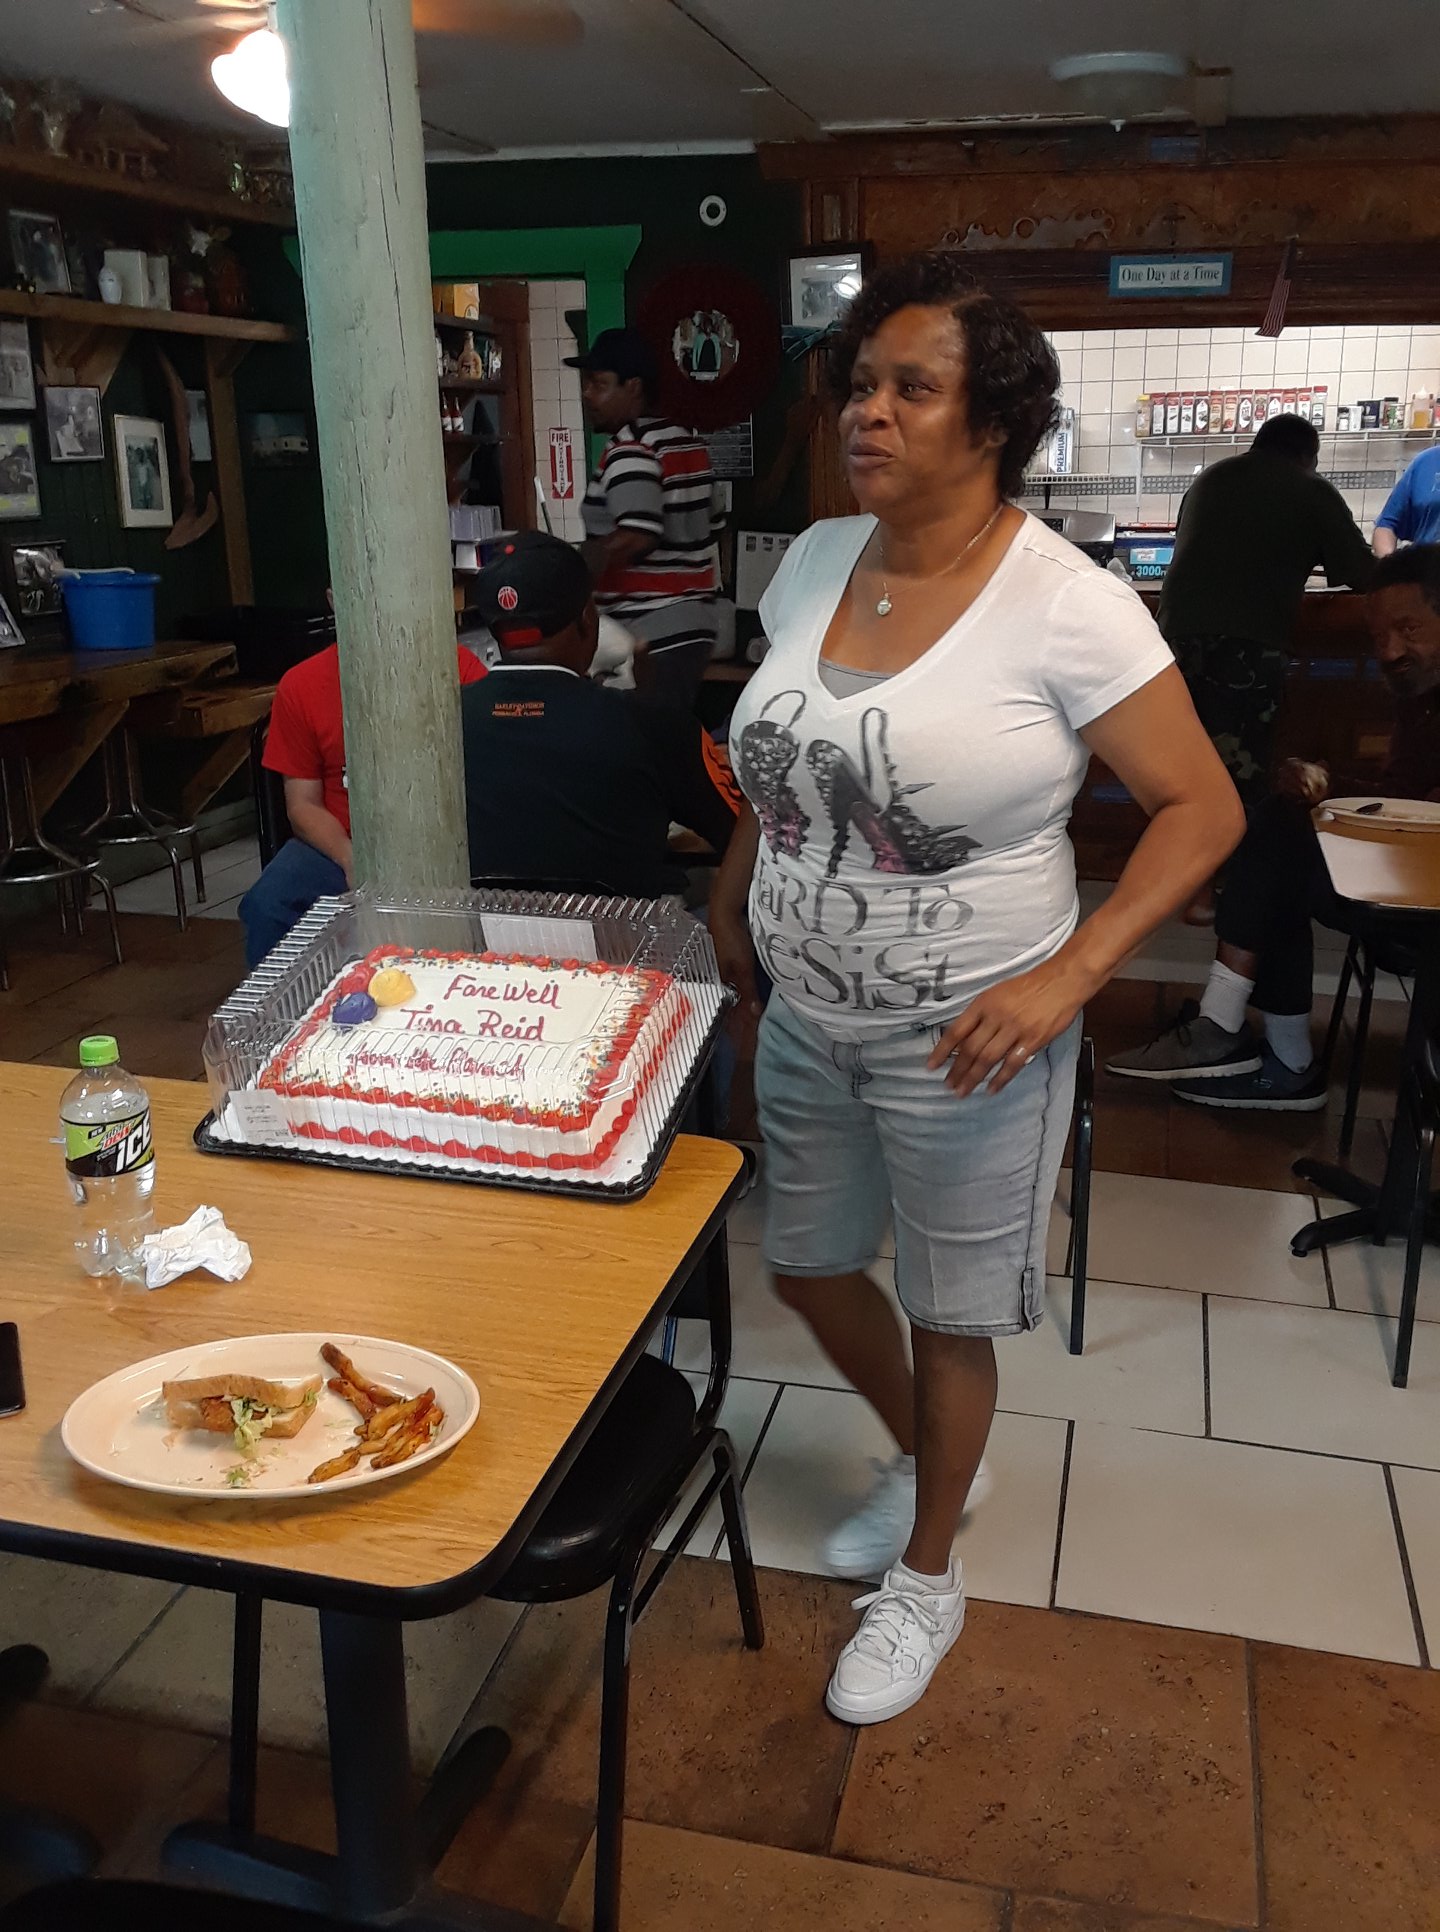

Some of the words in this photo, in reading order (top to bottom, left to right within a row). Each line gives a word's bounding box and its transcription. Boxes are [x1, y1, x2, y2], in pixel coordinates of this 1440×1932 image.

[1122, 267, 1145, 281] One
[1147, 266, 1166, 285] Day
[1170, 268, 1180, 281] at
[1183, 270, 1190, 280] a
[1192, 265, 1220, 280] Time
[551, 432, 569, 443] FIRE
[1056, 432, 1066, 473] PREMIUM
[400, 1004, 466, 1036] Tina
[477, 1009, 545, 1042] Reid
[115, 1109, 152, 1173] ICE
